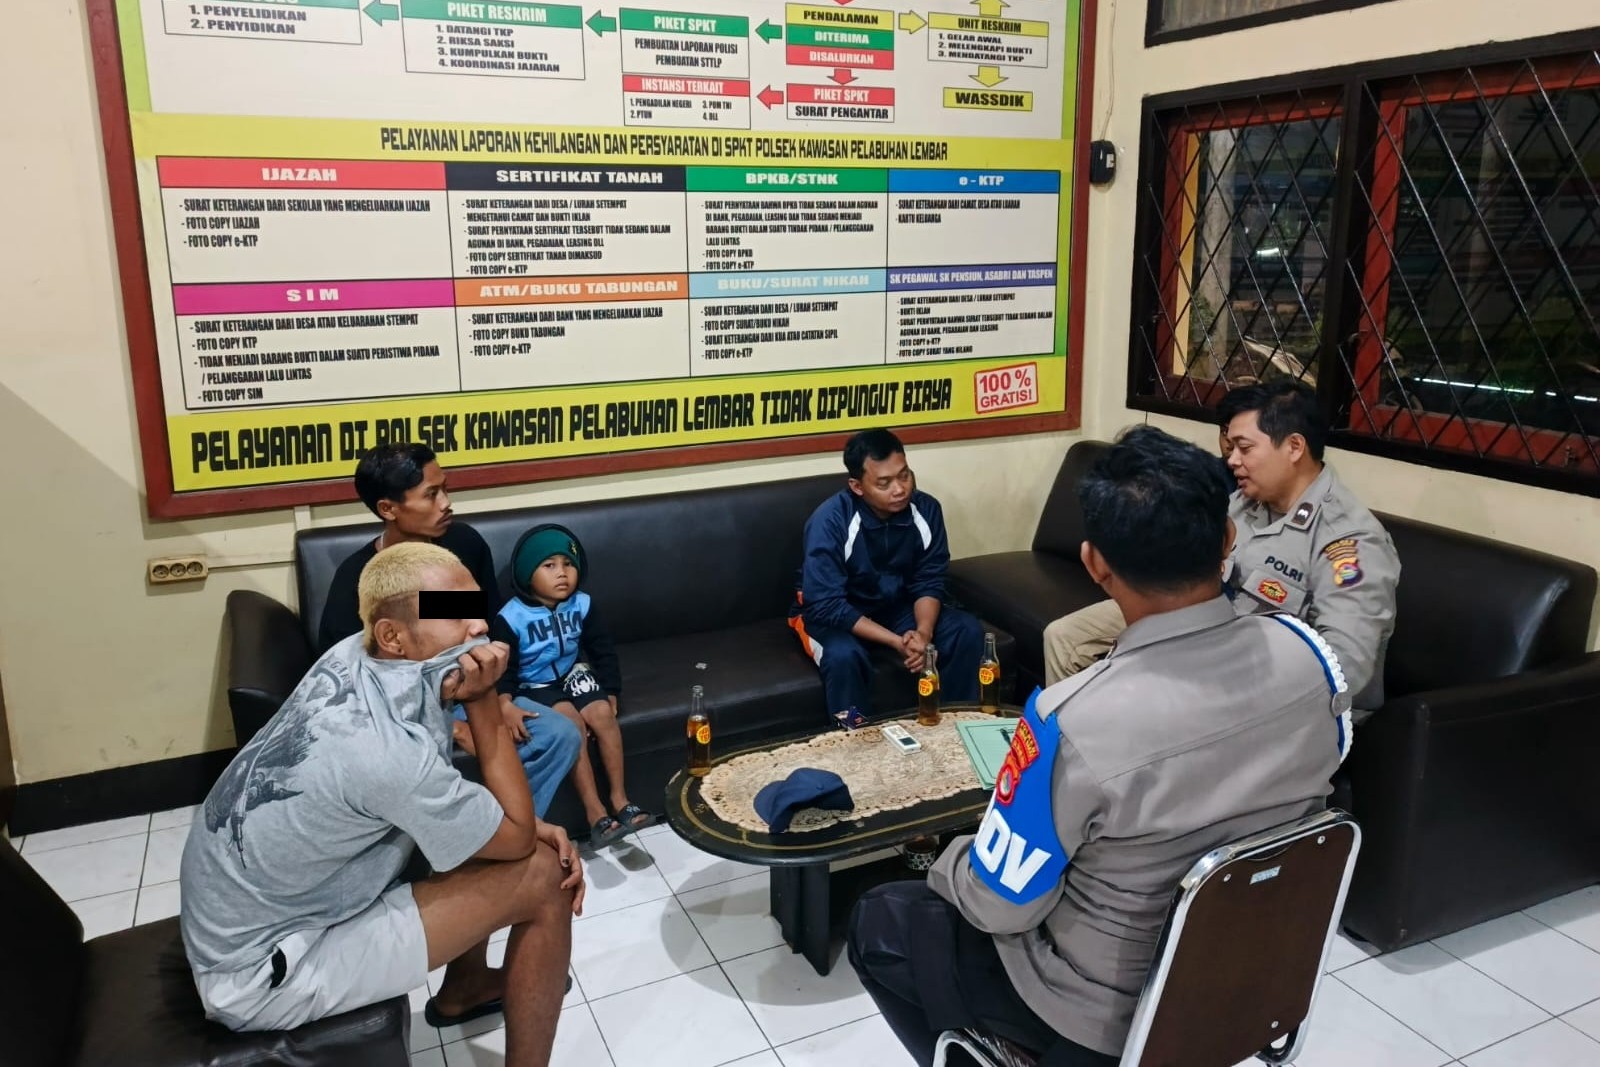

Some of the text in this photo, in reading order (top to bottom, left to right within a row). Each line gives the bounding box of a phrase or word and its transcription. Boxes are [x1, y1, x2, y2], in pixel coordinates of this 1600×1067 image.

[189, 5, 306, 21] 1. PENYELIDIKAN
[448, 3, 546, 22] PIKET RESKRIM
[804, 11, 878, 24] PENDALAMAN
[190, 19, 295, 34] 2. PENYIDIKAN
[447, 25, 491, 35] DATANGI
[494, 28, 513, 36] TKP
[654, 16, 716, 32] PIKET SPKT
[958, 18, 1021, 32] UNIT RESKRIM
[449, 37, 481, 46] RIKSA
[484, 39, 514, 47] SAKSI
[815, 31, 869, 44] DITERIMA
[948, 34, 975, 42] GELAR
[635, 38, 738, 54] PEMBUATAN LAPORAN POLISI
[949, 43, 1004, 52] MELENGKAPI
[450, 49, 514, 58] KUMPULKAN
[517, 52, 547, 60] BUKTI
[656, 55, 722, 68] PEMBUATAN STTLP
[810, 51, 874, 64] DISALURKAN
[949, 52, 1005, 60] MENDATANGI
[451, 60, 515, 70] KOORDINASI
[518, 63, 560, 72] JAJARAN
[642, 79, 724, 93] INSTANSI TERKAIT
[814, 88, 869, 102] PIKET SPKT
[955, 92, 1024, 106] WASSDIK
[796, 106, 888, 119] SURAT PENGANTAR
[381, 128, 947, 160] PELAYANAN LAPORAN KEHILANGAN DAN PERSYARATAN DI SPKT POLSEK KAWASAN PELABUHAN LEMBAR
[262, 168, 336, 181] IJAZAH
[497, 170, 662, 183] SERTIFIKAT TANAH
[746, 173, 838, 185] BPKB/STNK
[184, 199, 210, 211] SURAT
[213, 199, 264, 211] KETERANGAN
[267, 199, 286, 211] DARI
[287, 200, 322, 211] SEKOLAH
[323, 200, 344, 211] YANG
[346, 200, 404, 211] MENGELUARKAN
[187, 217, 207, 229] FOTO
[209, 218, 230, 229] COPY
[188, 235, 257, 248] FOTO COPY e-KTP
[718, 275, 869, 290] BUKU/SURAT NIKAH
[890, 274, 900, 284] SK
[940, 272, 949, 282] SK
[1012, 271, 1027, 280] DAN
[1028, 269, 1053, 279] TASPEN
[480, 280, 678, 297] ATM/BUKU TABUNGAN
[194, 320, 220, 333] SURAT
[223, 318, 273, 332] KETERANGAN
[276, 318, 294, 330] DARI
[296, 317, 315, 329] DESA
[317, 316, 335, 328] ATAU
[386, 314, 418, 326] STEMPAT
[473, 326, 565, 340] FOTO COPY BUKU TABUNGAN
[197, 336, 257, 351] FOTO COPY KTP
[200, 346, 439, 368] TIDAK MENJADI BARANG BUKTI DALAM SUATU PERISTIWA PIDANA
[705, 348, 752, 359] FOTO COPY e-KTP
[207, 371, 263, 385] PELANGGARAN
[266, 370, 283, 382] LALU
[286, 368, 311, 380] LINTAS
[978, 369, 1032, 393] 100 %
[203, 388, 263, 402] FOTO COPY SIM
[980, 388, 1033, 407] GRATIS!
[191, 423, 333, 474] PELAYANAN
[339, 420, 367, 461] DI
[465, 407, 563, 450] KAWASAN
[569, 401, 677, 441] PELABUHAN
[684, 393, 755, 430] LEMBAR
[762, 387, 813, 425] TIDAK
[818, 382, 899, 421] DIPUNGUT
[903, 378, 952, 413] BIAYA
[1265, 556, 1304, 582] POLRI
